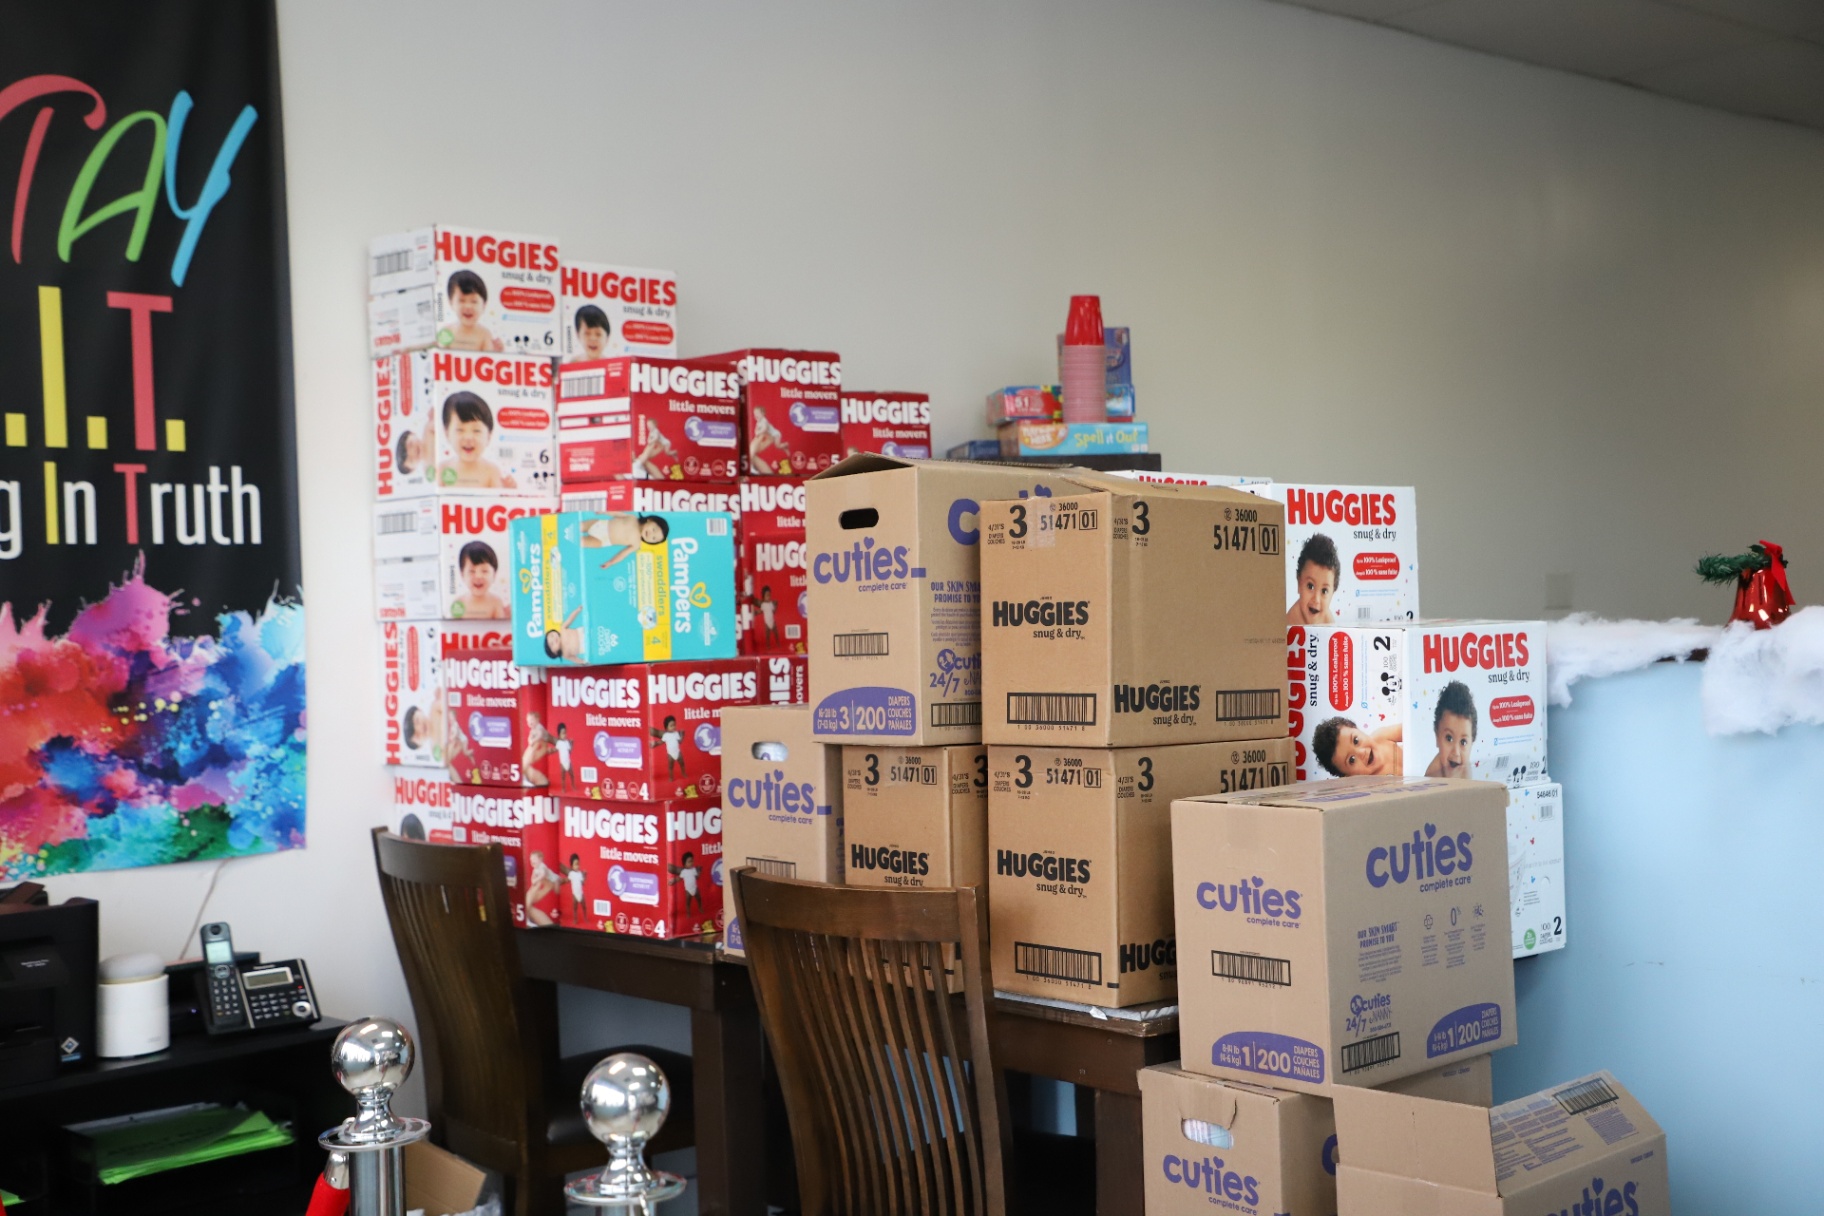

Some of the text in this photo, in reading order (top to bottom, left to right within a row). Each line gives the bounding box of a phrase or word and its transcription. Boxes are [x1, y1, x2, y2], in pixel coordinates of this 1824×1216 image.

[435, 231, 559, 272] HUGGIES
[501, 271, 552, 284] snug dry
[561, 266, 677, 306] HUGGIES
[623, 305, 671, 318] snug dry
[544, 331, 554, 346] 6
[434, 352, 552, 387] HUGGIES
[747, 355, 841, 386] HUGGIES
[631, 363, 740, 400] HUGGIES
[497, 388, 547, 400] snug dry
[780, 387, 838, 400] little movers
[669, 399, 735, 416] little movers
[841, 398, 931, 426] HUGGIES
[377, 356, 393, 495] HUGGIES
[872, 427, 928, 440] little movers
[539, 448, 549, 464] 6
[726, 460, 737, 477] 5
[44, 461, 262, 545] In Truth
[740, 483, 807, 513] HUGG
[1058, 502, 1078, 511] 36000
[1287, 488, 1396, 526] HUGGIES
[777, 516, 801, 529] little
[1009, 504, 1028, 538] 3
[1040, 511, 1096, 531] 51471 01
[1132, 501, 1150, 535] 3
[1234, 509, 1258, 522] 36000
[1213, 525, 1277, 552] 51471 01
[1353, 527, 1397, 542] snug & dry
[813, 536, 909, 584] cuties
[527, 543, 544, 638] Pampers
[655, 554, 667, 616] swaddlers
[671, 537, 699, 634] Pampers
[858, 583, 889, 593] complete
[930, 580, 963, 592] OUR SKIN
[934, 593, 962, 603] PROMISE
[992, 600, 1089, 627] HUGGIES
[1033, 627, 1081, 640] snug & dry
[1373, 636, 1391, 651] 2
[1331, 637, 1339, 670] Leakproof
[1423, 632, 1529, 674] HUGGIES
[446, 657, 520, 690] HUGGIES
[1307, 634, 1319, 707] snug & dry
[1488, 669, 1530, 684] snug & dry
[385, 621, 400, 765] HUGGIES
[552, 675, 640, 709] HUGGIES
[648, 671, 757, 705] HUGGIES
[929, 671, 960, 698] 24/7
[467, 693, 517, 708] little movers
[888, 696, 911, 706] DIAPERS
[1114, 684, 1200, 713] HUGGIES
[586, 713, 642, 729] little movers
[684, 707, 710, 721] little
[840, 706, 850, 730] 3
[856, 706, 886, 730] 200
[888, 708, 912, 718] COUCHES
[1153, 713, 1194, 727] snug & dry
[888, 718, 912, 730] PAÑALES
[905, 756, 921, 765] 36000
[1063, 757, 1083, 767] 36000
[1242, 749, 1266, 763] 36000
[510, 763, 520, 782] 5
[864, 754, 880, 786] 3
[890, 766, 935, 783] 51471 01
[973, 755, 988, 787] 3
[1014, 754, 1033, 788] 3
[1046, 768, 1100, 786] 51471 01
[1137, 756, 1154, 792] 3
[1220, 764, 1287, 793] 51471 01
[639, 782, 649, 800] 4
[727, 768, 814, 815] cuties
[452, 793, 524, 829] HUGGIES
[768, 813, 813, 825] complete care
[564, 806, 659, 845] HUGGIES
[600, 846, 659, 865] little movers
[851, 843, 929, 875] HUGGIES
[1366, 822, 1473, 888] cuties
[996, 849, 1091, 884] HUGGIES
[884, 875, 909, 887] snug &
[1036, 883, 1084, 898] snug & dry
[1419, 875, 1471, 893] complete care
[1196, 875, 1302, 919] cuties
[516, 904, 525, 921] 5
[1246, 916, 1300, 929] complete care
[654, 919, 666, 938] 4
[1553, 915, 1562, 936] 2
[1120, 938, 1177, 974] HUGG
[1362, 993, 1391, 1011] cuties
[1346, 1014, 1367, 1038] 24/7
[1458, 1020, 1480, 1045] 200
[1447, 1027, 1454, 1048] 1
[1241, 1046, 1251, 1067] 1
[1257, 1048, 1291, 1074] 200
[1293, 1045, 1319, 1058] DIAPERS
[1293, 1055, 1320, 1069] COUCHES
[1293, 1065, 1320, 1079] PAÑALES
[1163, 1154, 1259, 1206] cuties
[1208, 1196, 1258, 1216] complete care
